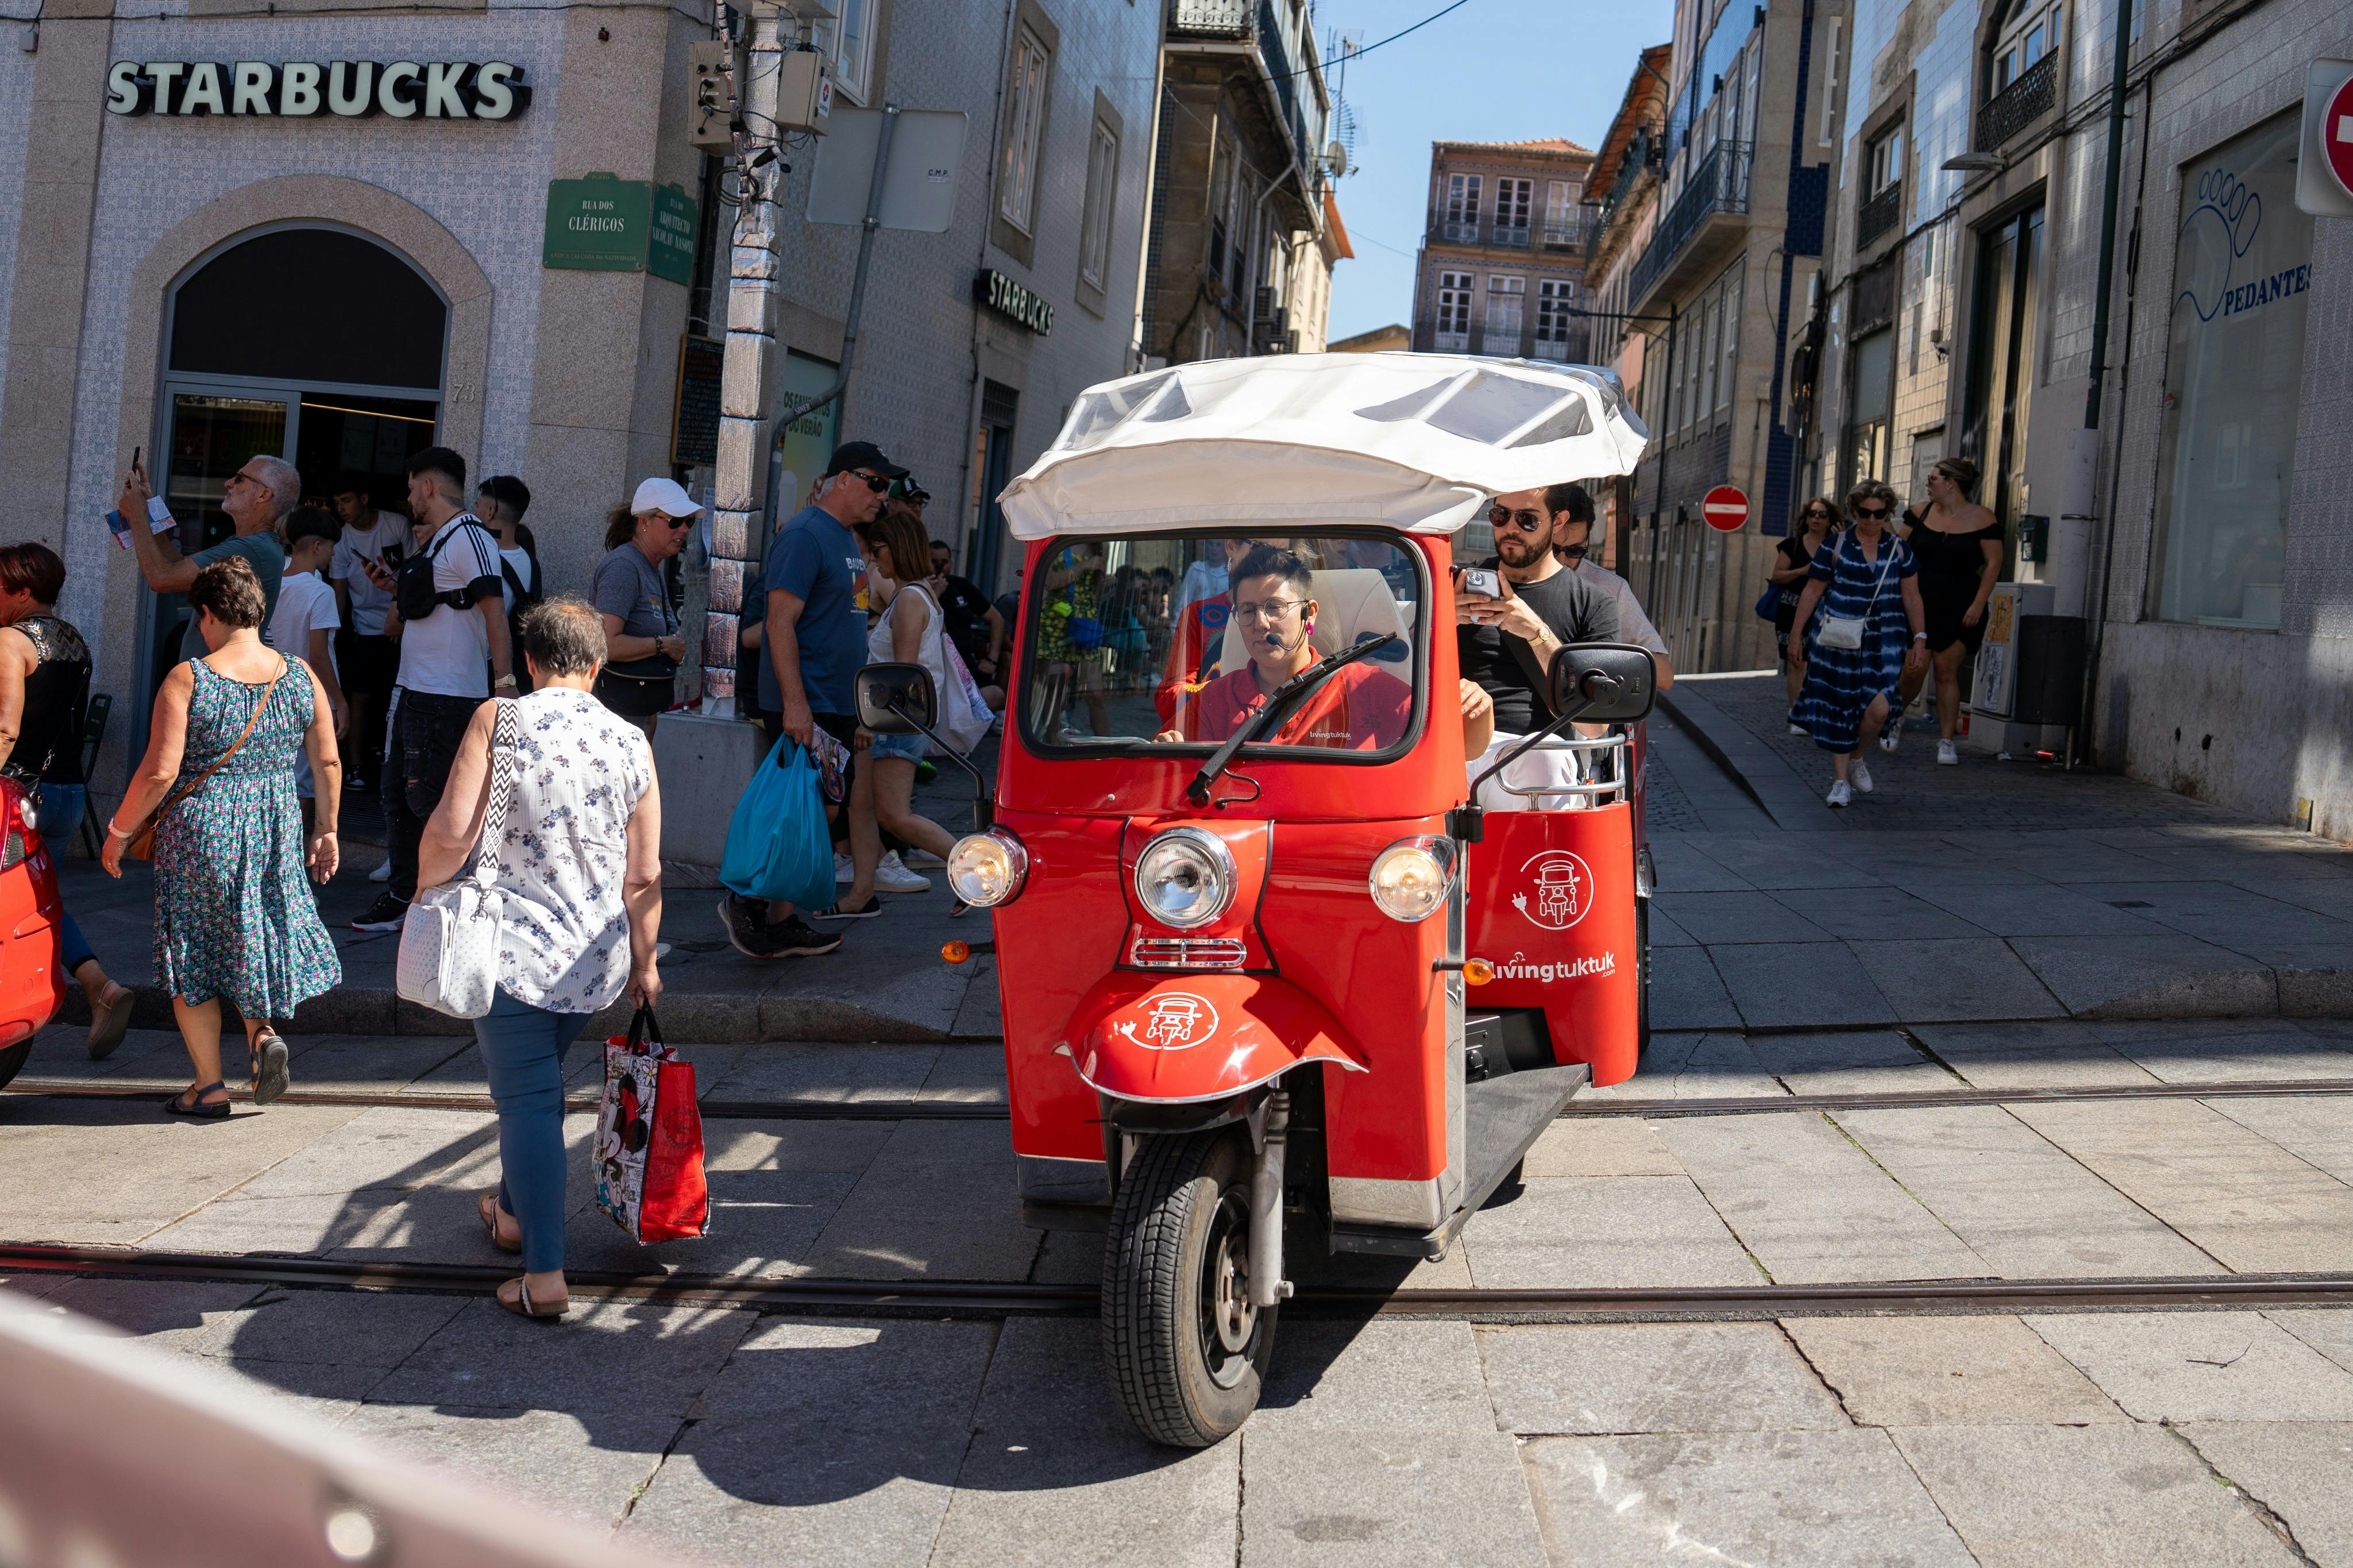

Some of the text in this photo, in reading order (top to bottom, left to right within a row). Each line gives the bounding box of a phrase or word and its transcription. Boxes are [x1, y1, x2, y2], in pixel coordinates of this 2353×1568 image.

[106, 60, 515, 119] STARBUCKS
[583, 200, 614, 211] RUA DOS
[568, 214, 624, 232] CLÉRIGOS
[659, 211, 691, 235] ARQUITECTO
[652, 226, 694, 254] NICOLAU NASONI
[989, 269, 1055, 336] STARBUCKS
[453, 384, 475, 402] 73
[784, 391, 794, 409] OS
[800, 416, 823, 437] VERÃO
[1602, 968, 1615, 978] .com
